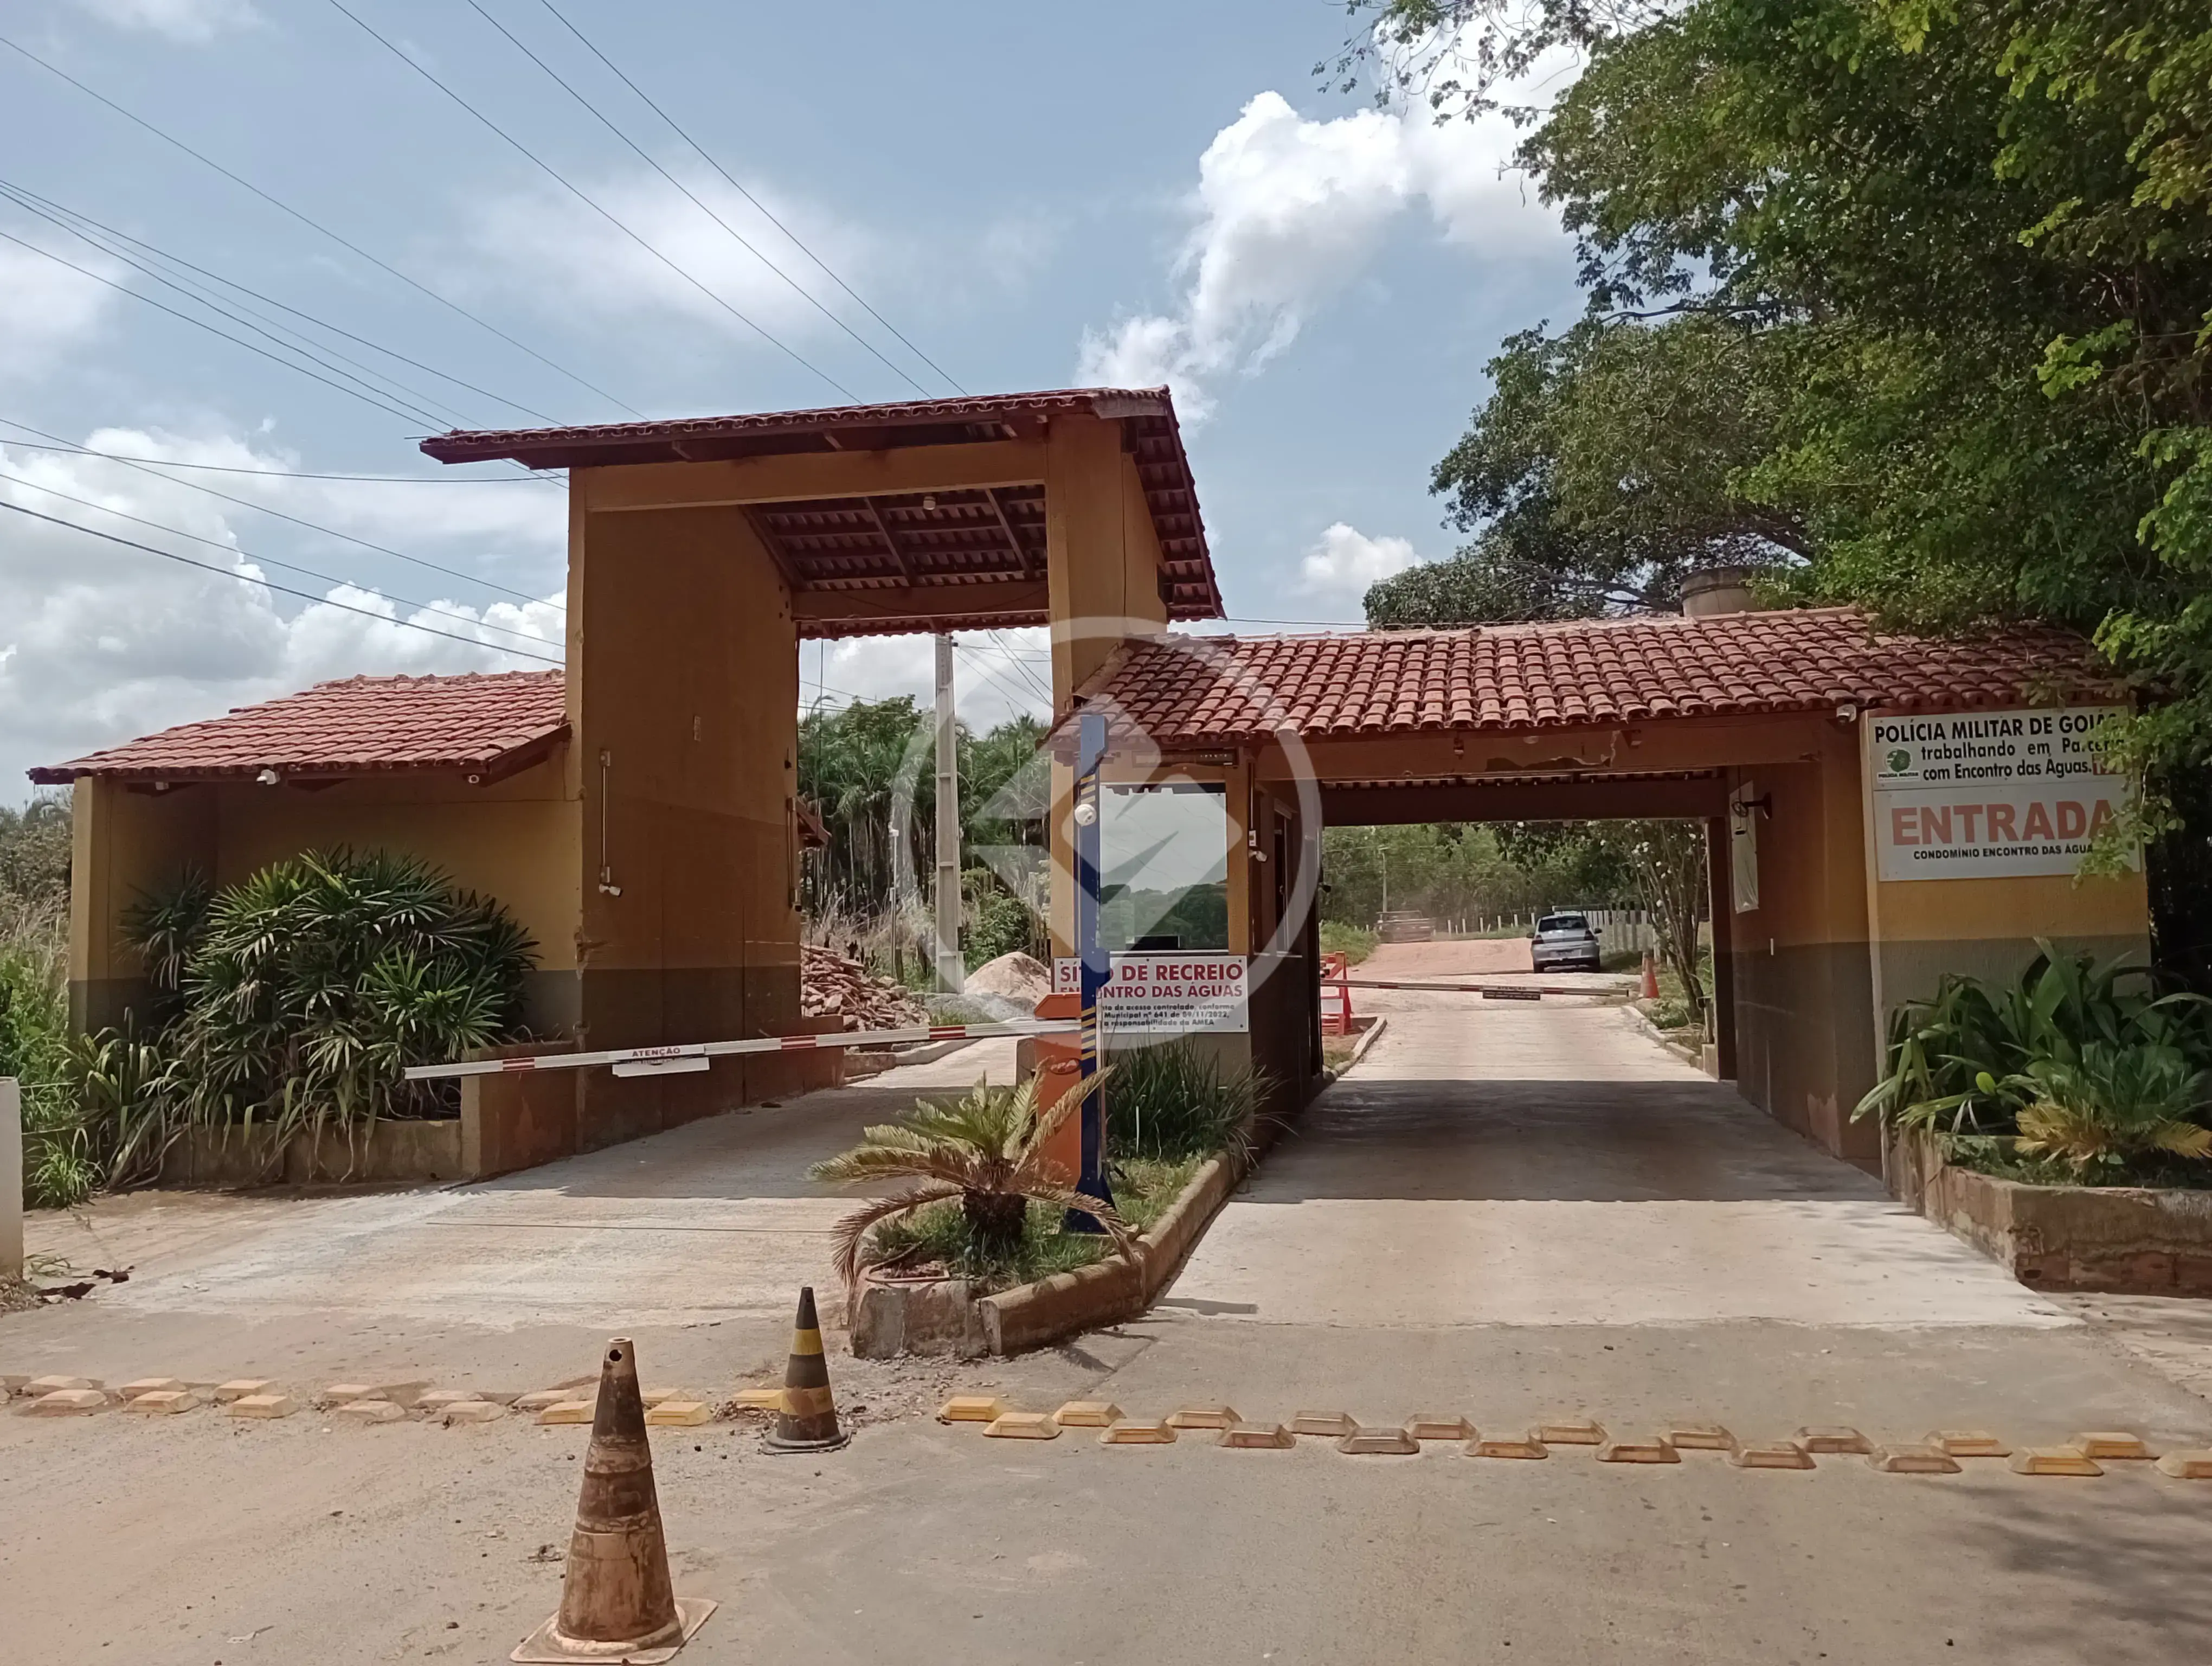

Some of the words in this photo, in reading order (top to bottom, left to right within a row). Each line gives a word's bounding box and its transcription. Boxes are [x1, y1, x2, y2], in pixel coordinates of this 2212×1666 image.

[1875, 719, 1946, 743] POLÍCIA
[1952, 719, 2024, 739] MILITAR
[2029, 717, 2053, 735] DE
[1921, 740, 2015, 760] trabalhando
[2028, 742, 2050, 755] em
[1923, 768, 1950, 780] com
[1954, 763, 2012, 779] Encontro
[2017, 759, 2041, 776] das
[2046, 754, 2092, 778] Águas.
[1892, 799, 2122, 845] ENTRADA
[1914, 847, 1979, 860] CONDOMÍNIO
[1983, 846, 2039, 857] ENCONTRO
[2042, 845, 2061, 855] DAS
[2065, 843, 2093, 854] ÁGUA
[1122, 965, 1148, 981] DE
[1156, 964, 1243, 981] RECREIO
[1152, 985, 1182, 998] DAS
[1187, 982, 1243, 998] ÁGUAS
[632, 1048, 681, 1057] ATENÇÃO
